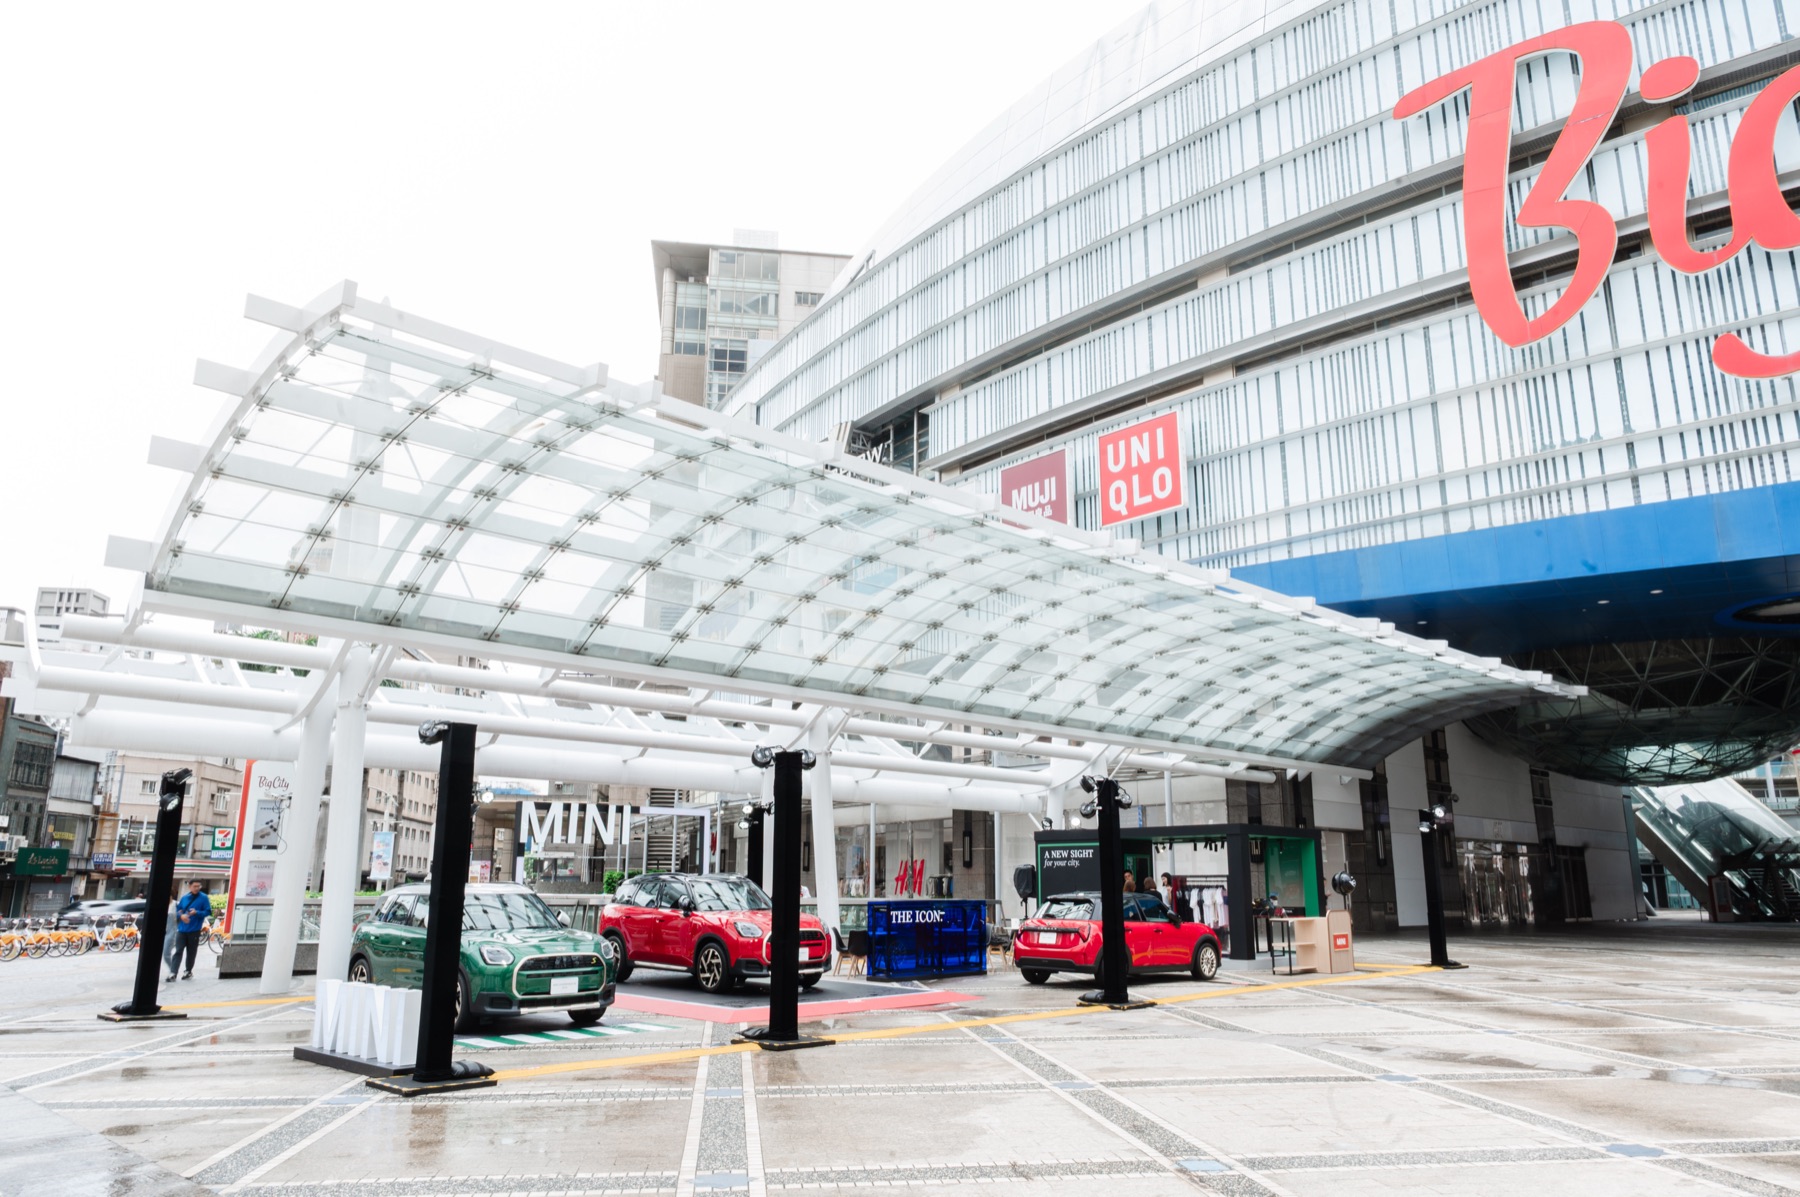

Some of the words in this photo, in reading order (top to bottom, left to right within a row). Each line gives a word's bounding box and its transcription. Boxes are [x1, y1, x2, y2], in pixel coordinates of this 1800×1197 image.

[1107, 427, 1165, 473] UNI
[1011, 476, 1057, 511] MUJI
[1108, 466, 1173, 516] QLO
[520, 801, 632, 845] MINI
[1043, 859, 1053, 868] for
[1053, 860, 1067, 868] your
[1044, 850, 1050, 858] A
[1051, 849, 1069, 858] NEW
[1070, 849, 1094, 858] SIGHT
[894, 859, 925, 896] HM
[890, 910, 913, 924] THE
[312, 979, 422, 1067] MINI
